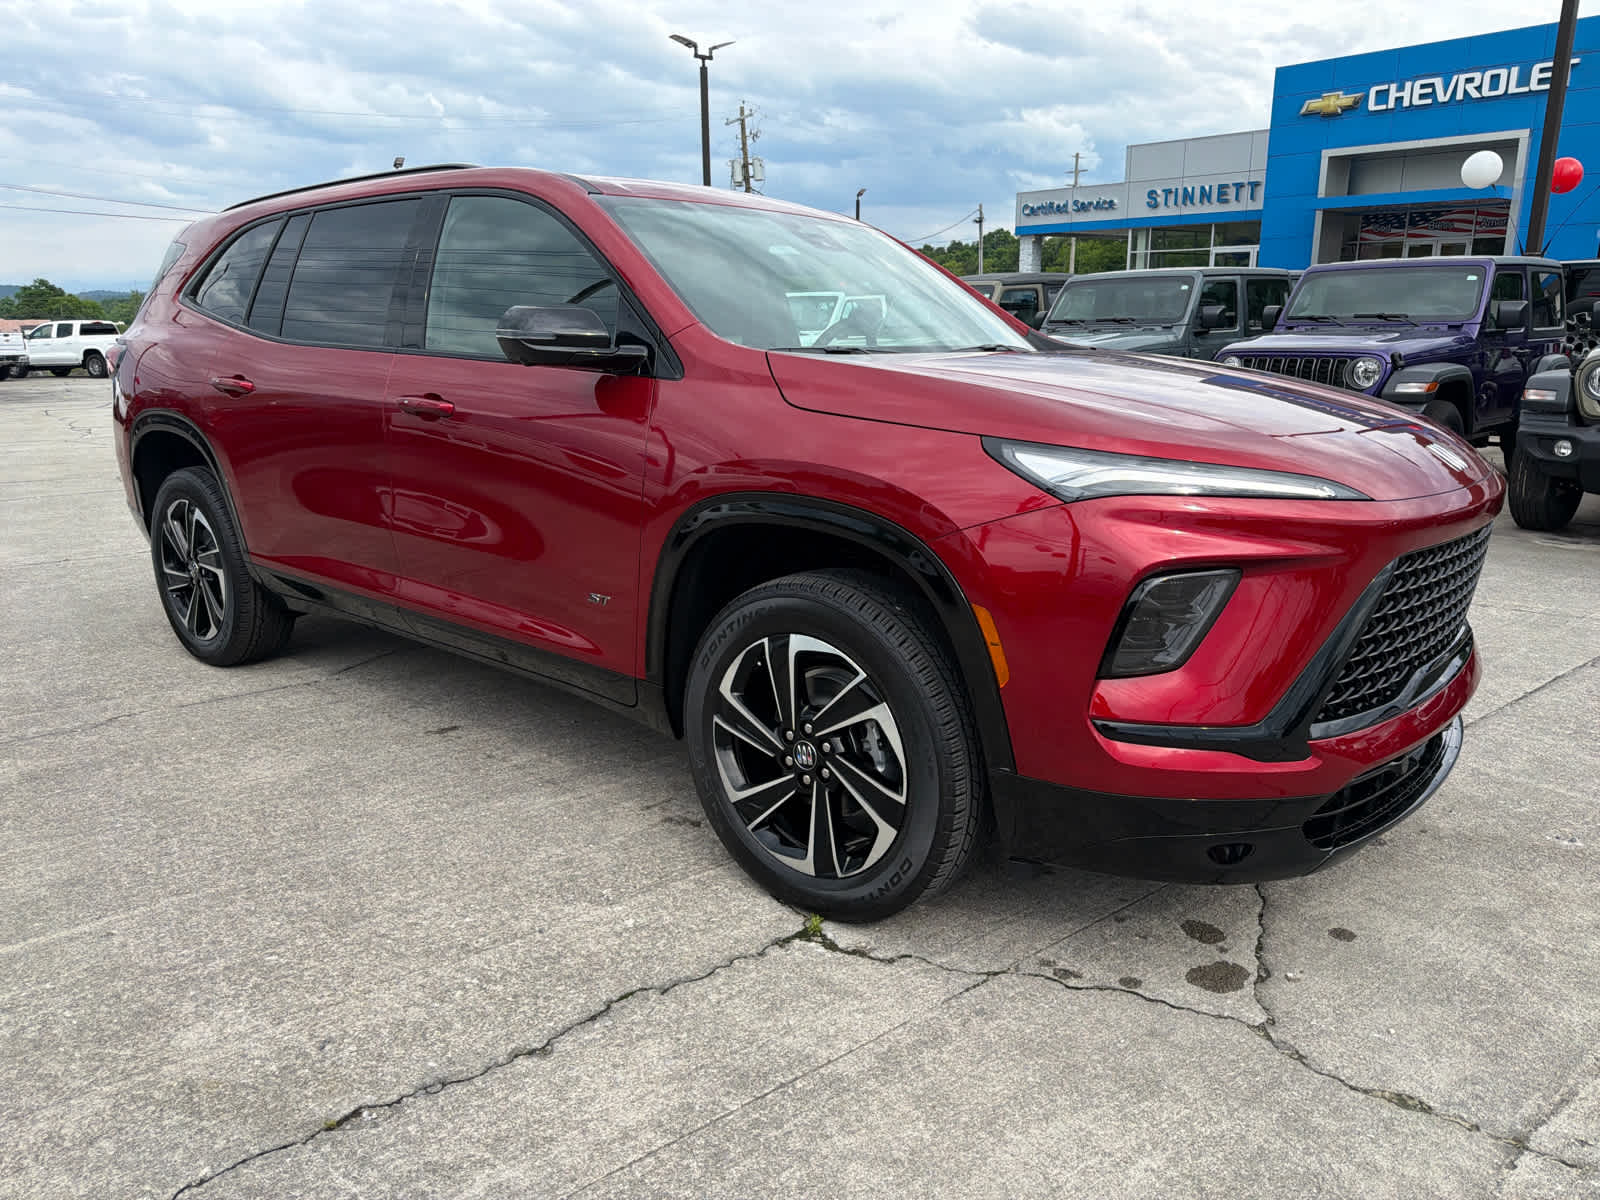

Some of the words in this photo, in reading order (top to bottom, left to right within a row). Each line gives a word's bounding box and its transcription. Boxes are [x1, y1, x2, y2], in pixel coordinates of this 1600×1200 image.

[1146, 181, 1262, 209] STINNETT
[1022, 199, 1069, 217] Certified
[1072, 197, 1118, 213] Service
[586, 592, 611, 607] ST
